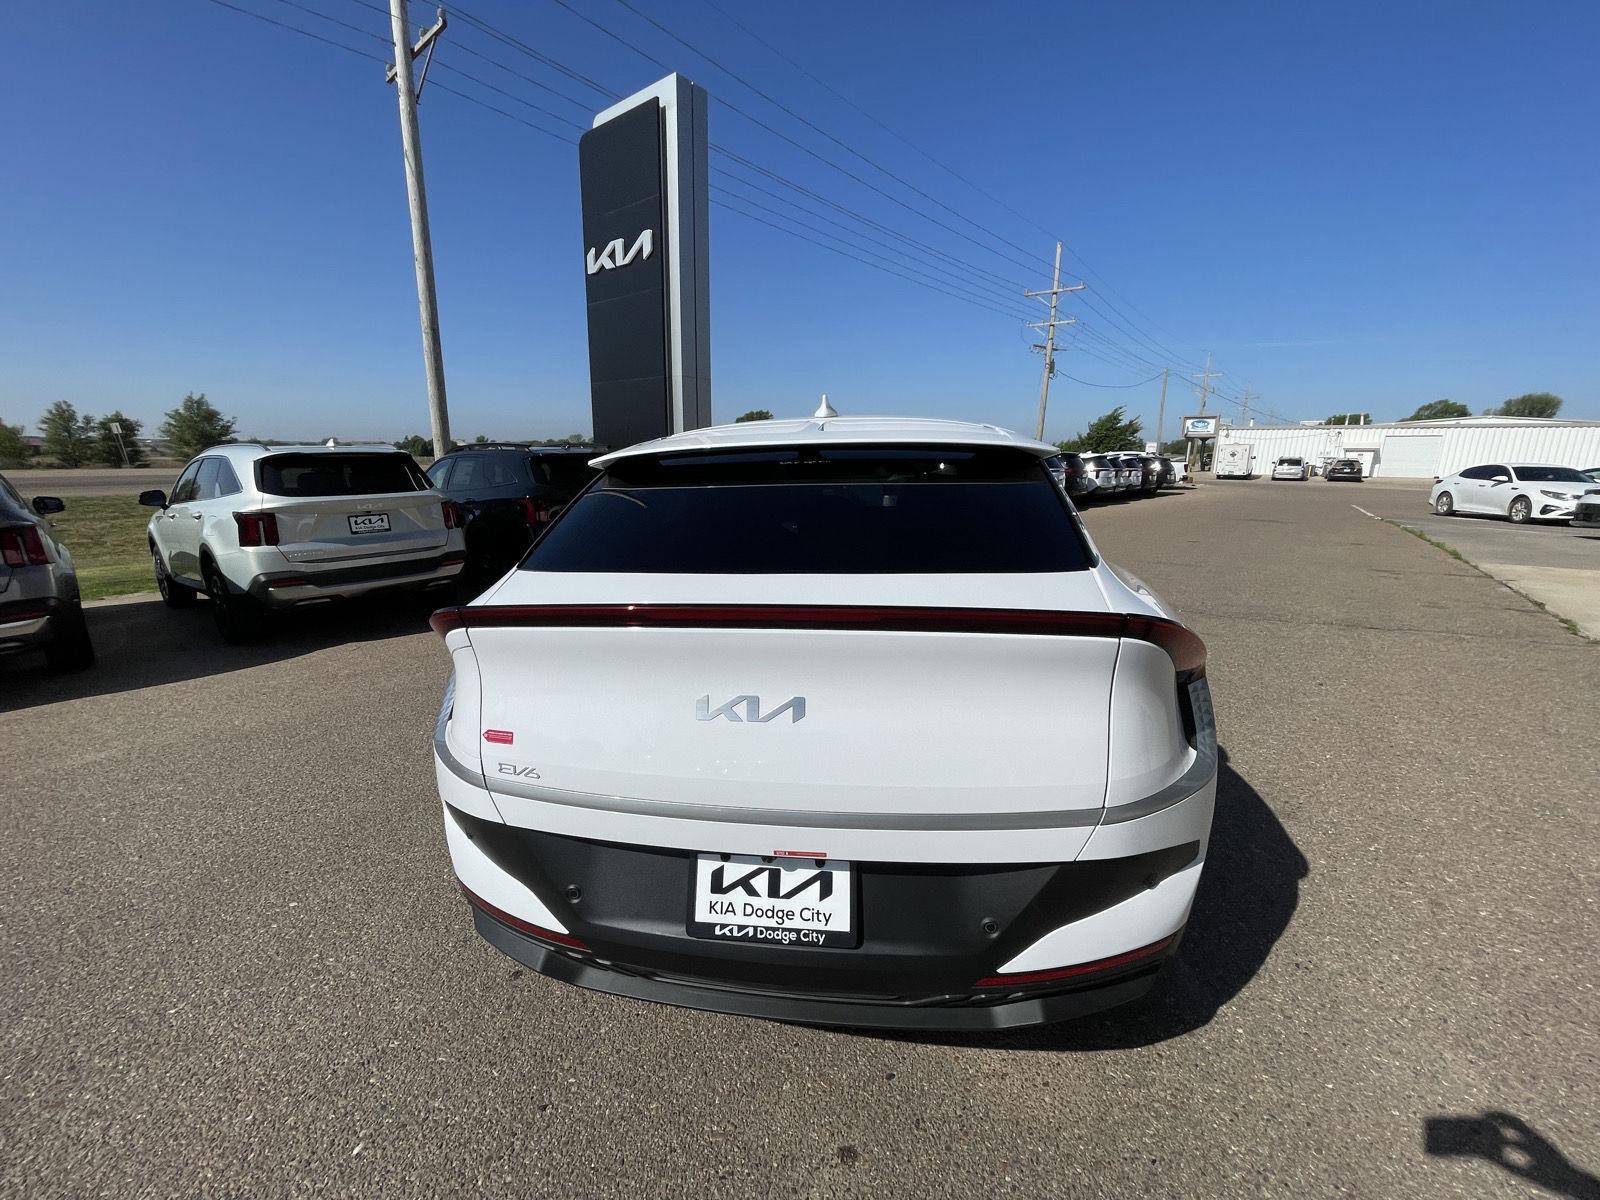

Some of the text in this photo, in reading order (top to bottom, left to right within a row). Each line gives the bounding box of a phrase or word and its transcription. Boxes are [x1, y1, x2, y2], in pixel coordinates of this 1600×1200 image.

[586, 229, 653, 275] KIA
[354, 517, 384, 525] KIA
[696, 694, 806, 723] KIA
[498, 762, 541, 780] EV6
[711, 864, 833, 902] KIA
[709, 900, 832, 926] KIA Dodge City
[714, 925, 826, 944] KIA Dodge City
